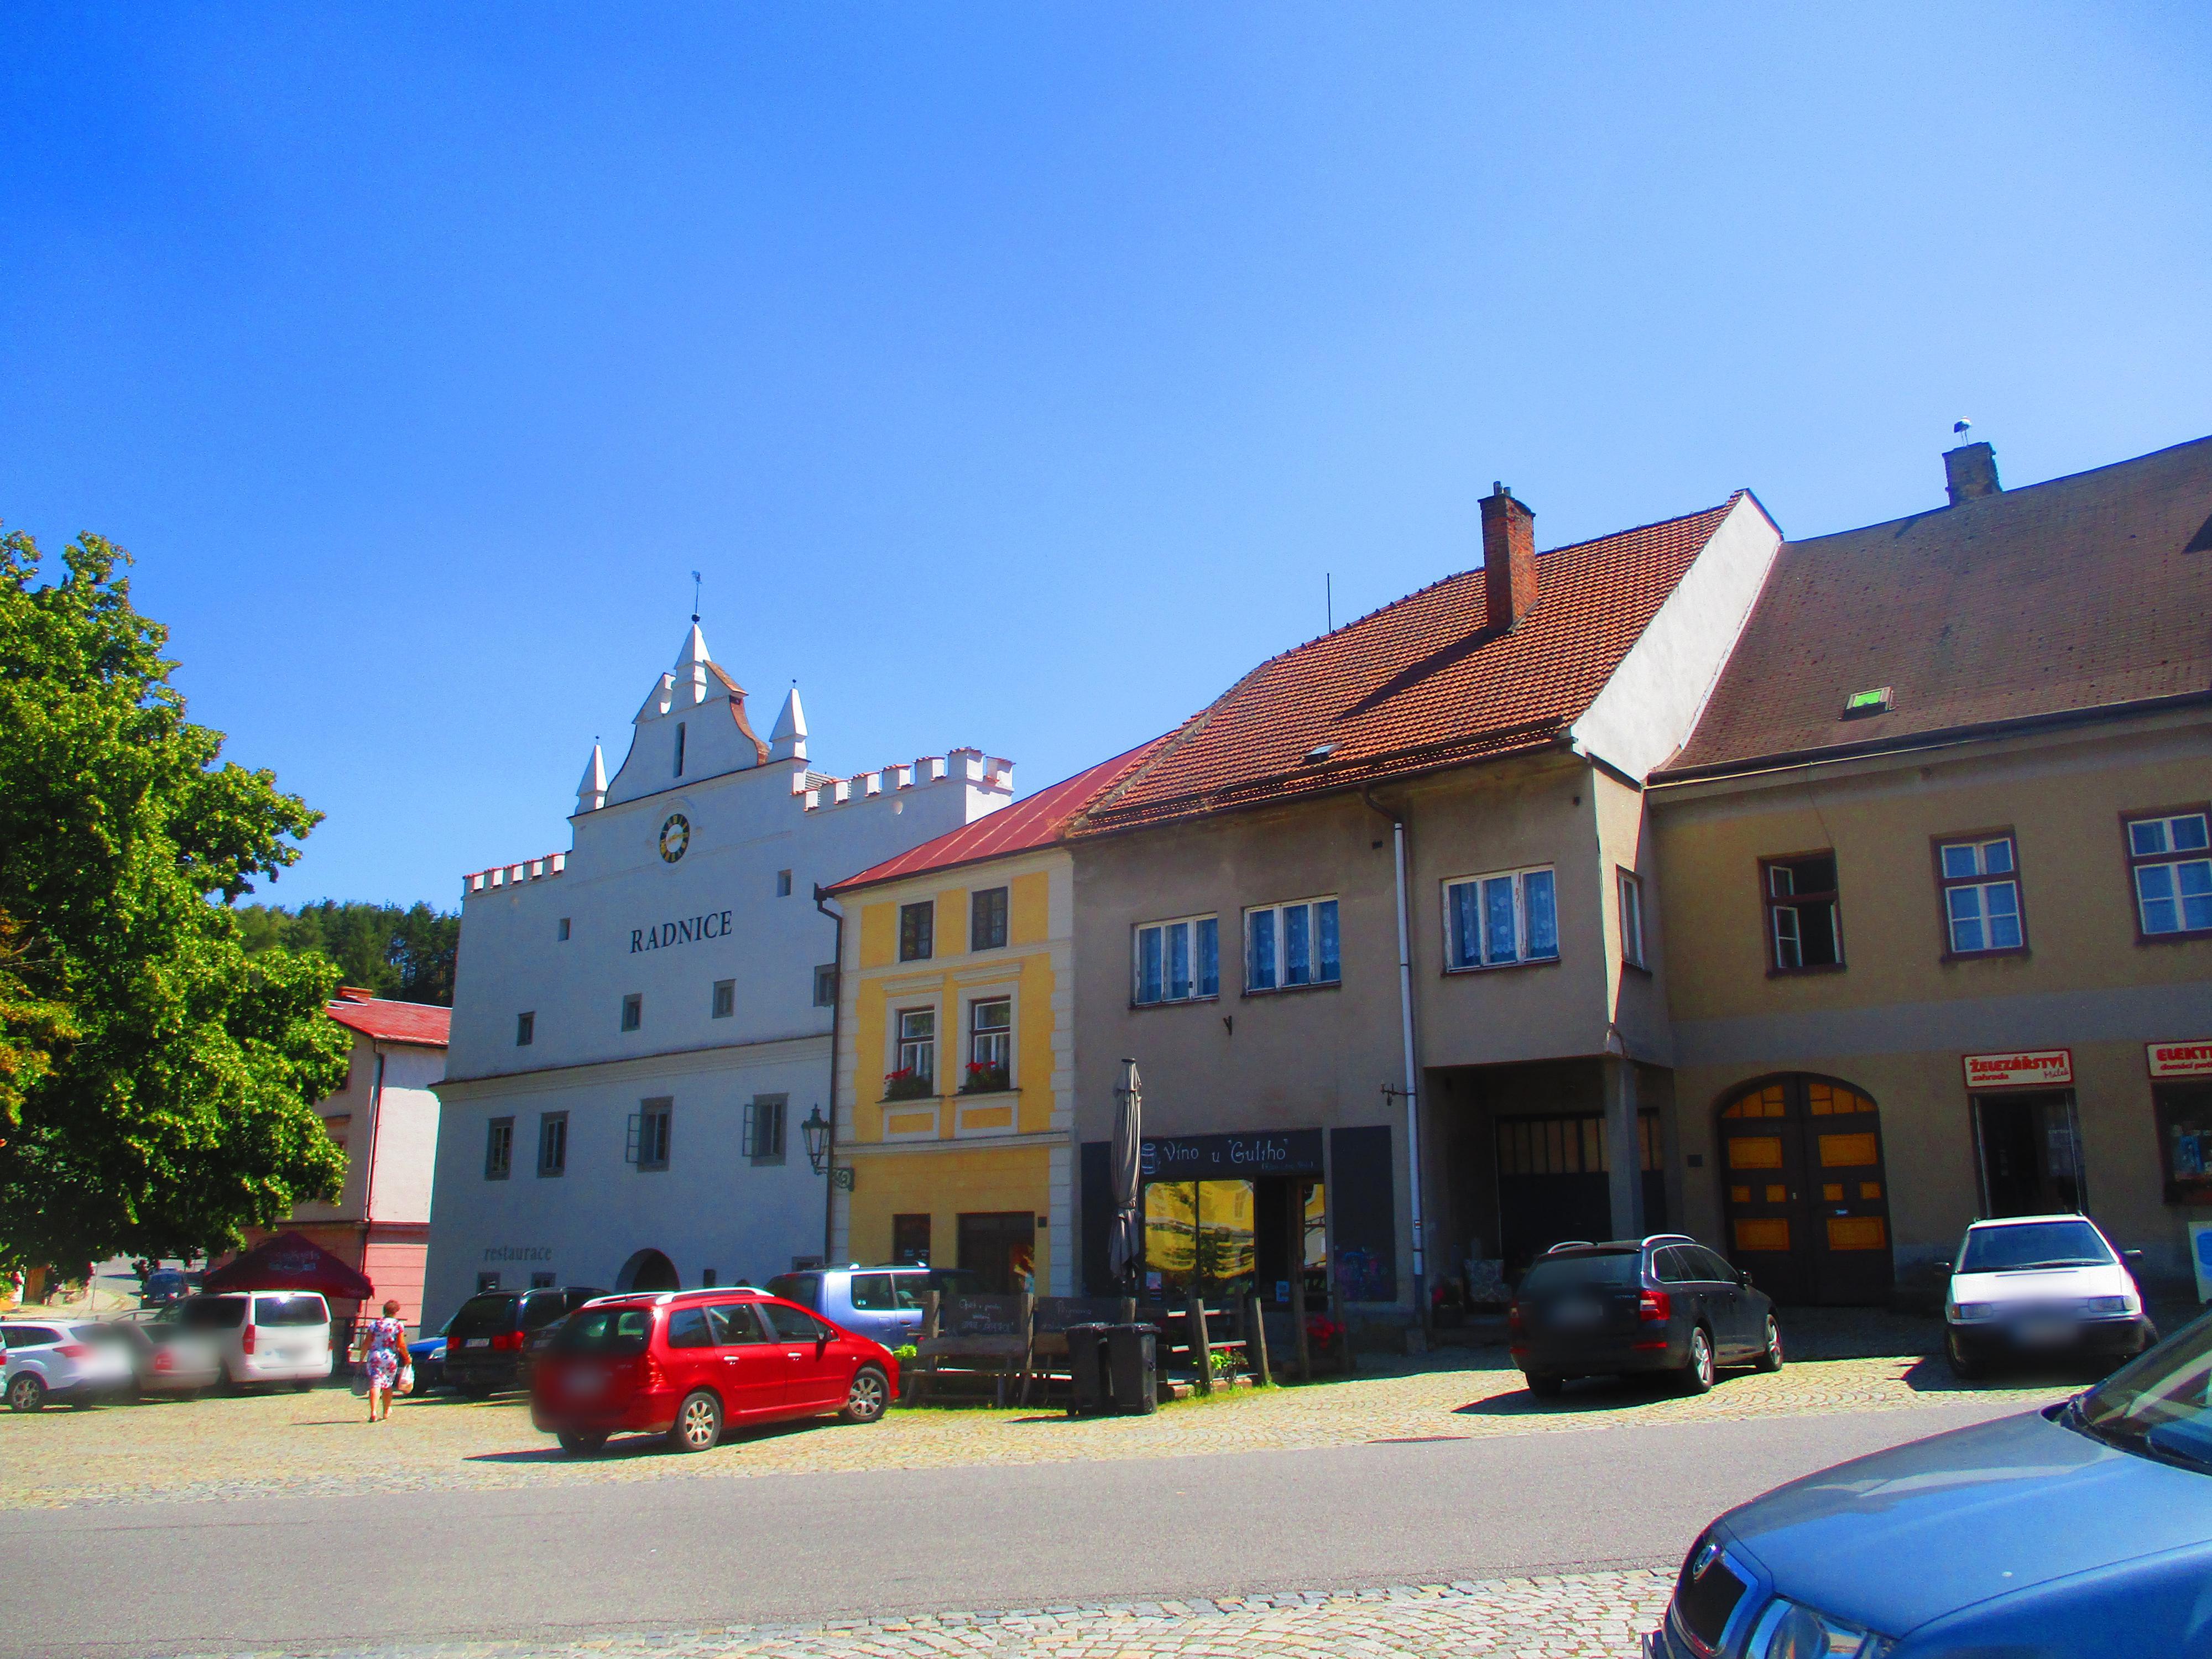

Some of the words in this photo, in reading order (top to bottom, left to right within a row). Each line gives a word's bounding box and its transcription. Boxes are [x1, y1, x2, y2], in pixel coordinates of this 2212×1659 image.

[630, 910, 732, 953] RADNICE
[1969, 1053, 2064, 1073] ŽELEZÁŘSTVÍ
[1164, 1141, 1199, 1161] Víno
[1212, 1152, 1220, 1162] u
[485, 1245, 552, 1261] restaurace
